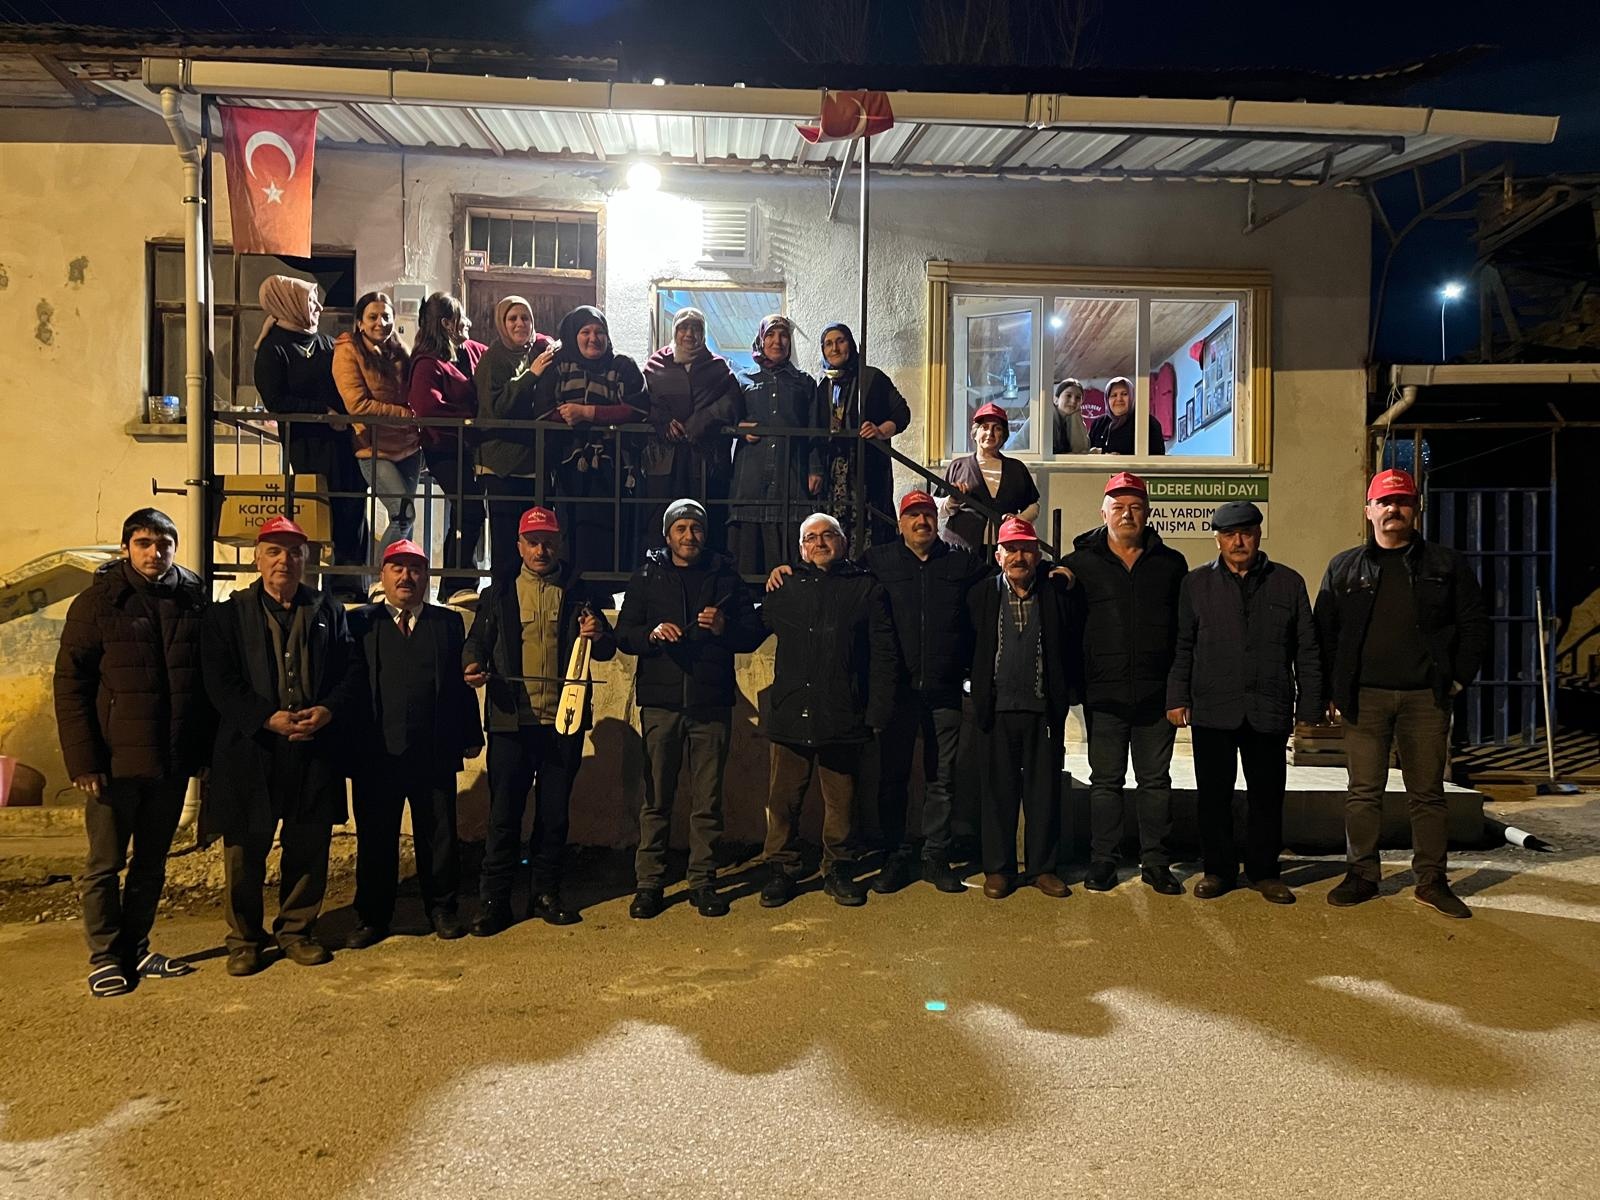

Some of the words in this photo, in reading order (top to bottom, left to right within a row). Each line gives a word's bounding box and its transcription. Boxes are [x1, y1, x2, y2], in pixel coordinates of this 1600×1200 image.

[1146, 480, 1191, 496] İLDERE
[1194, 481, 1226, 496] NURİ
[1228, 484, 1259, 496] DAYI
[1148, 508, 1168, 518] YAL
[1170, 508, 1216, 518] YARDIM
[245, 517, 271, 527] HO
[1150, 521, 1196, 533] ANIŞMA
